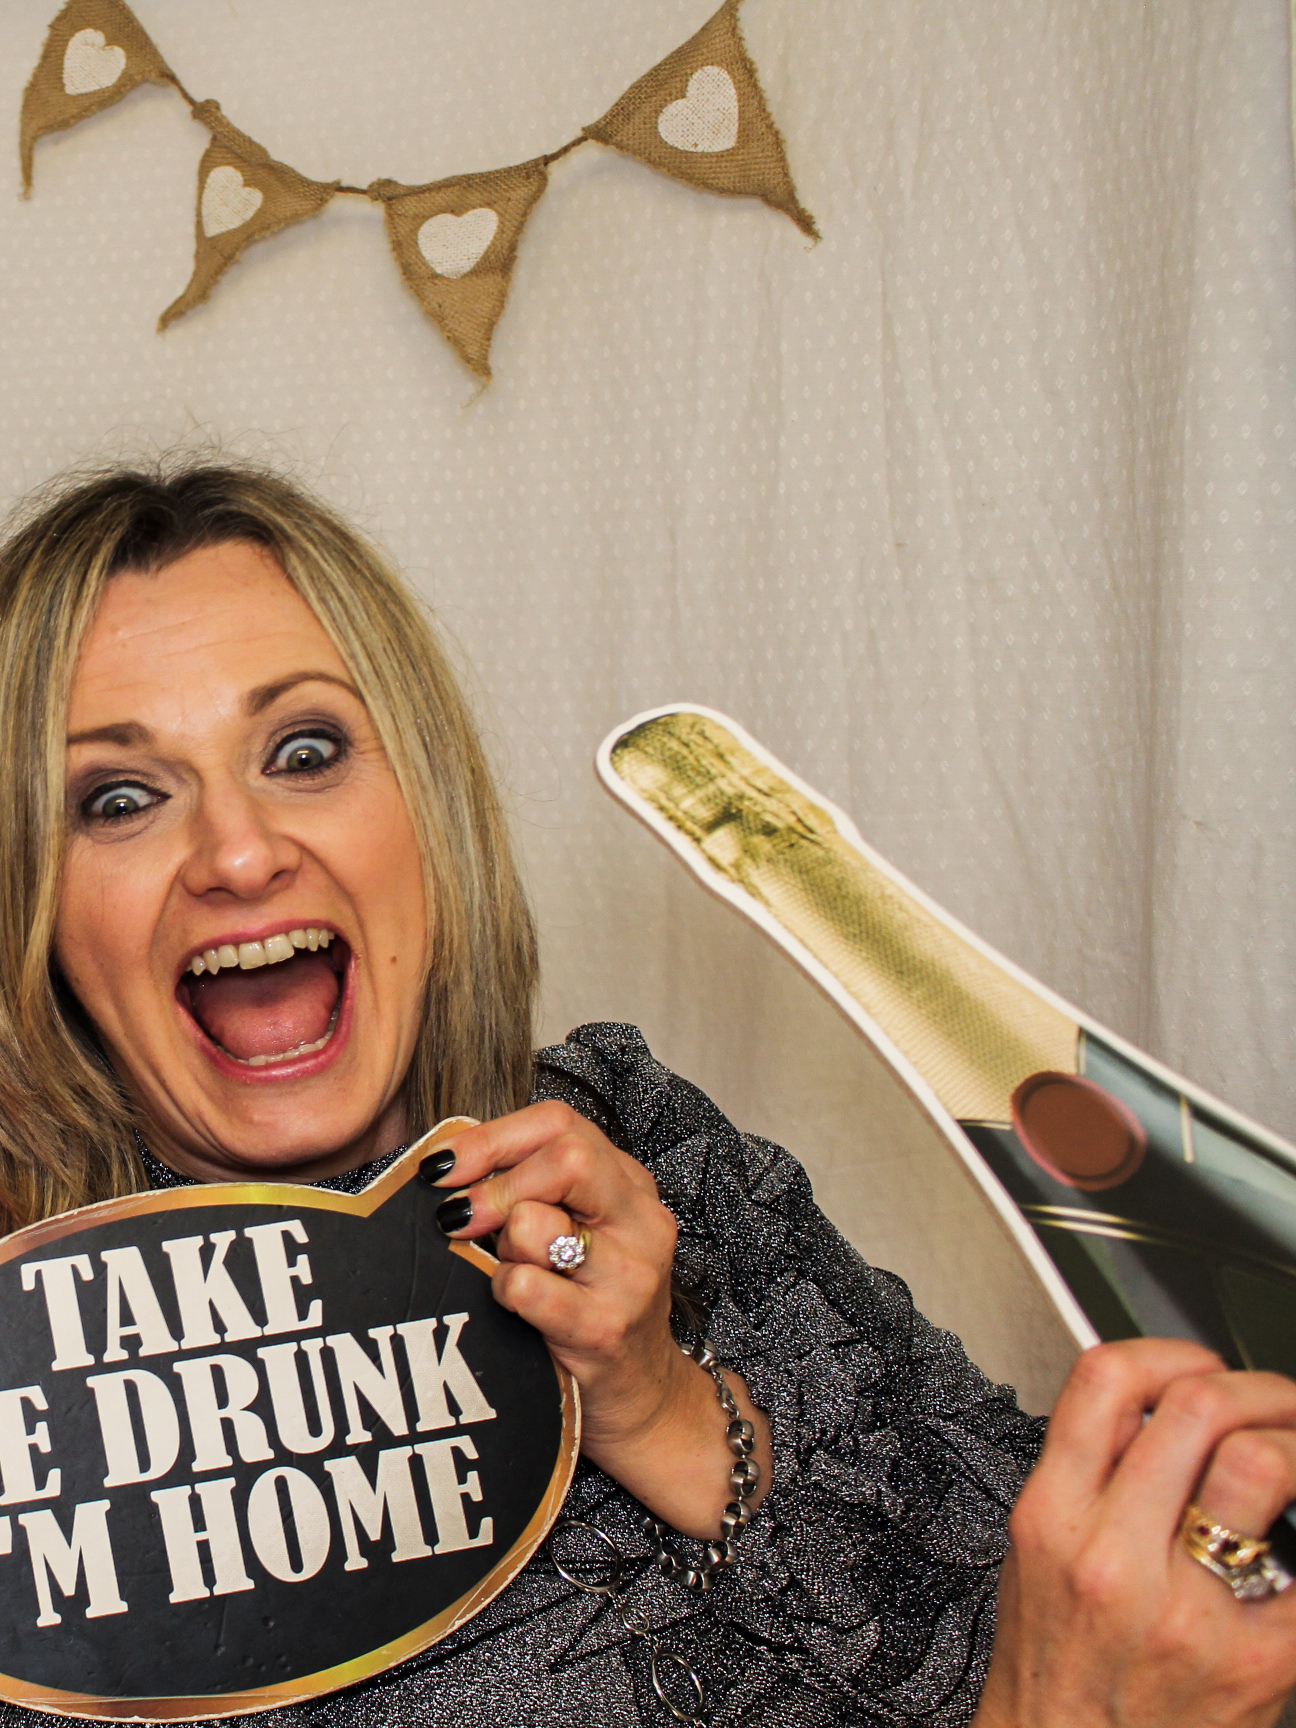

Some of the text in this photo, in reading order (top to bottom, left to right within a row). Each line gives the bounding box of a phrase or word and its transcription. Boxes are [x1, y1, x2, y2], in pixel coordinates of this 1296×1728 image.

[20, 1219, 323, 1371] TAKE
[86, 1312, 497, 1488] DRUNK
[150, 1435, 493, 1604] HOME
